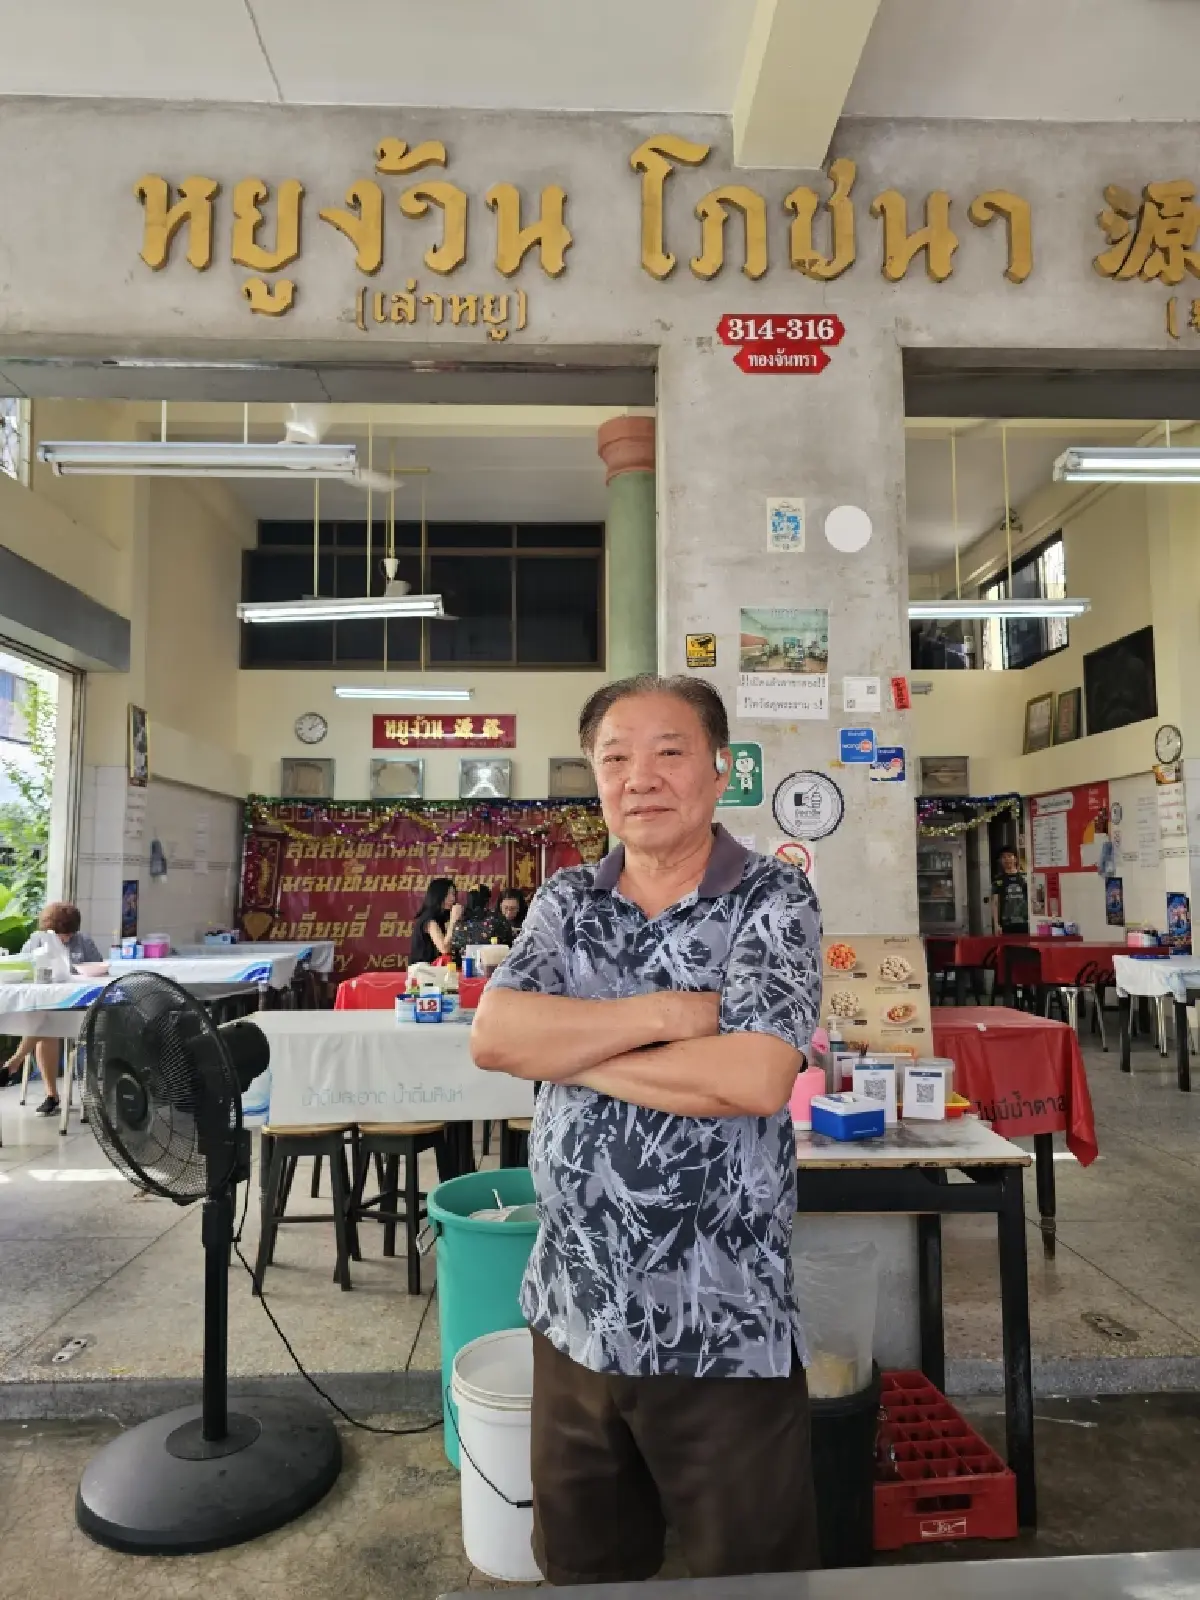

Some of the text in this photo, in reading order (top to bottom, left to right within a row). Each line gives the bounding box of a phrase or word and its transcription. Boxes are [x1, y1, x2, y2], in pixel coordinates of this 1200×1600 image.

[134, 134, 1032, 317] หยูง้วน โภชนา
[355, 278, 528, 340] (เล่าหยู)
[727, 318, 835, 340] 314-316
